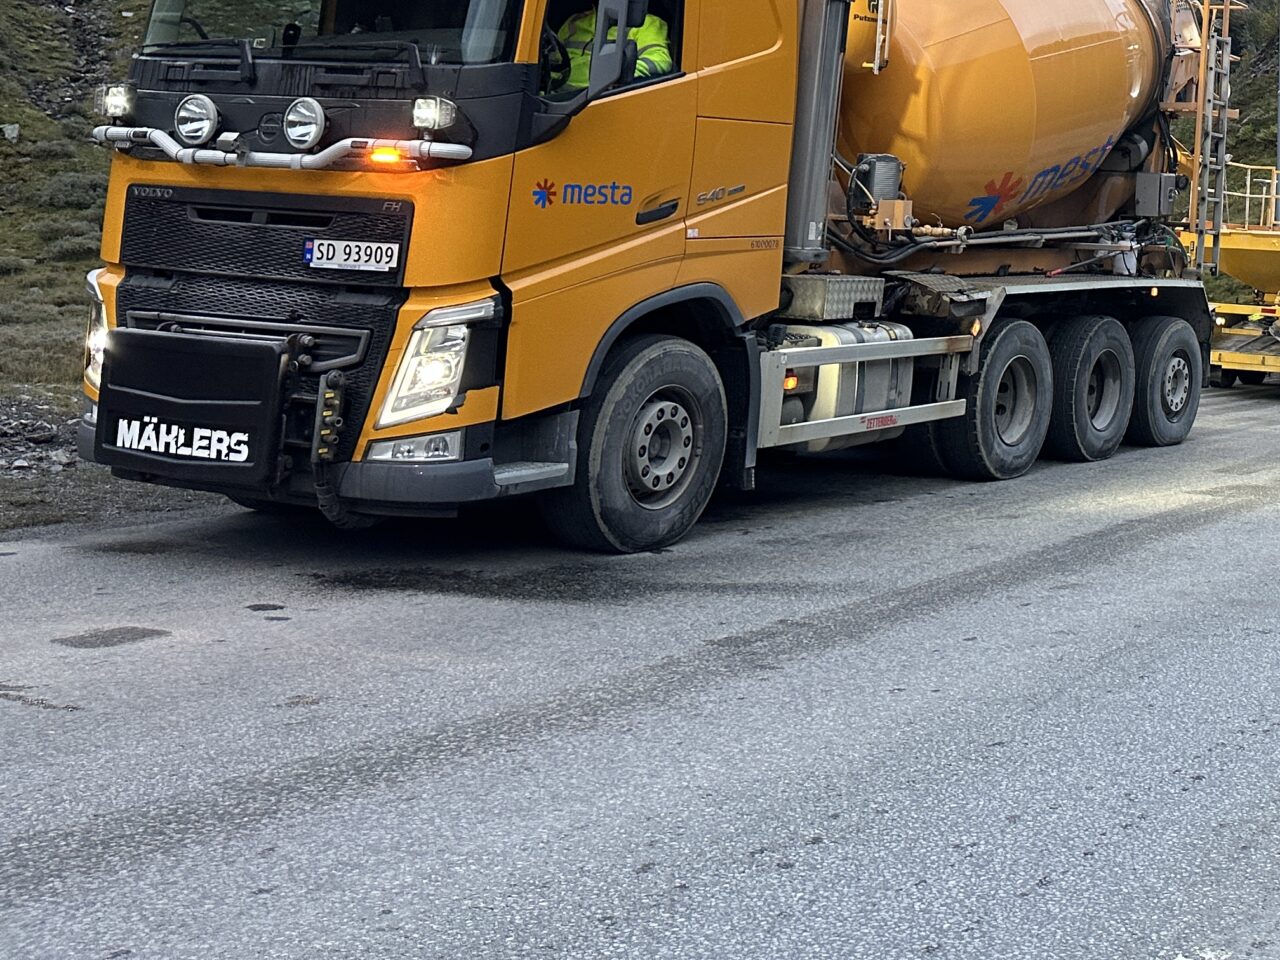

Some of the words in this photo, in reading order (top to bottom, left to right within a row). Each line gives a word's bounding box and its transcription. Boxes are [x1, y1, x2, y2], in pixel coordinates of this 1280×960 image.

[132, 187, 173, 198] VOLVO
[562, 181, 632, 205] mesta
[382, 201, 402, 212] FH
[316, 243, 336, 260] SD
[343, 244, 394, 264] 93909
[116, 416, 249, 462] MÄHLERS
